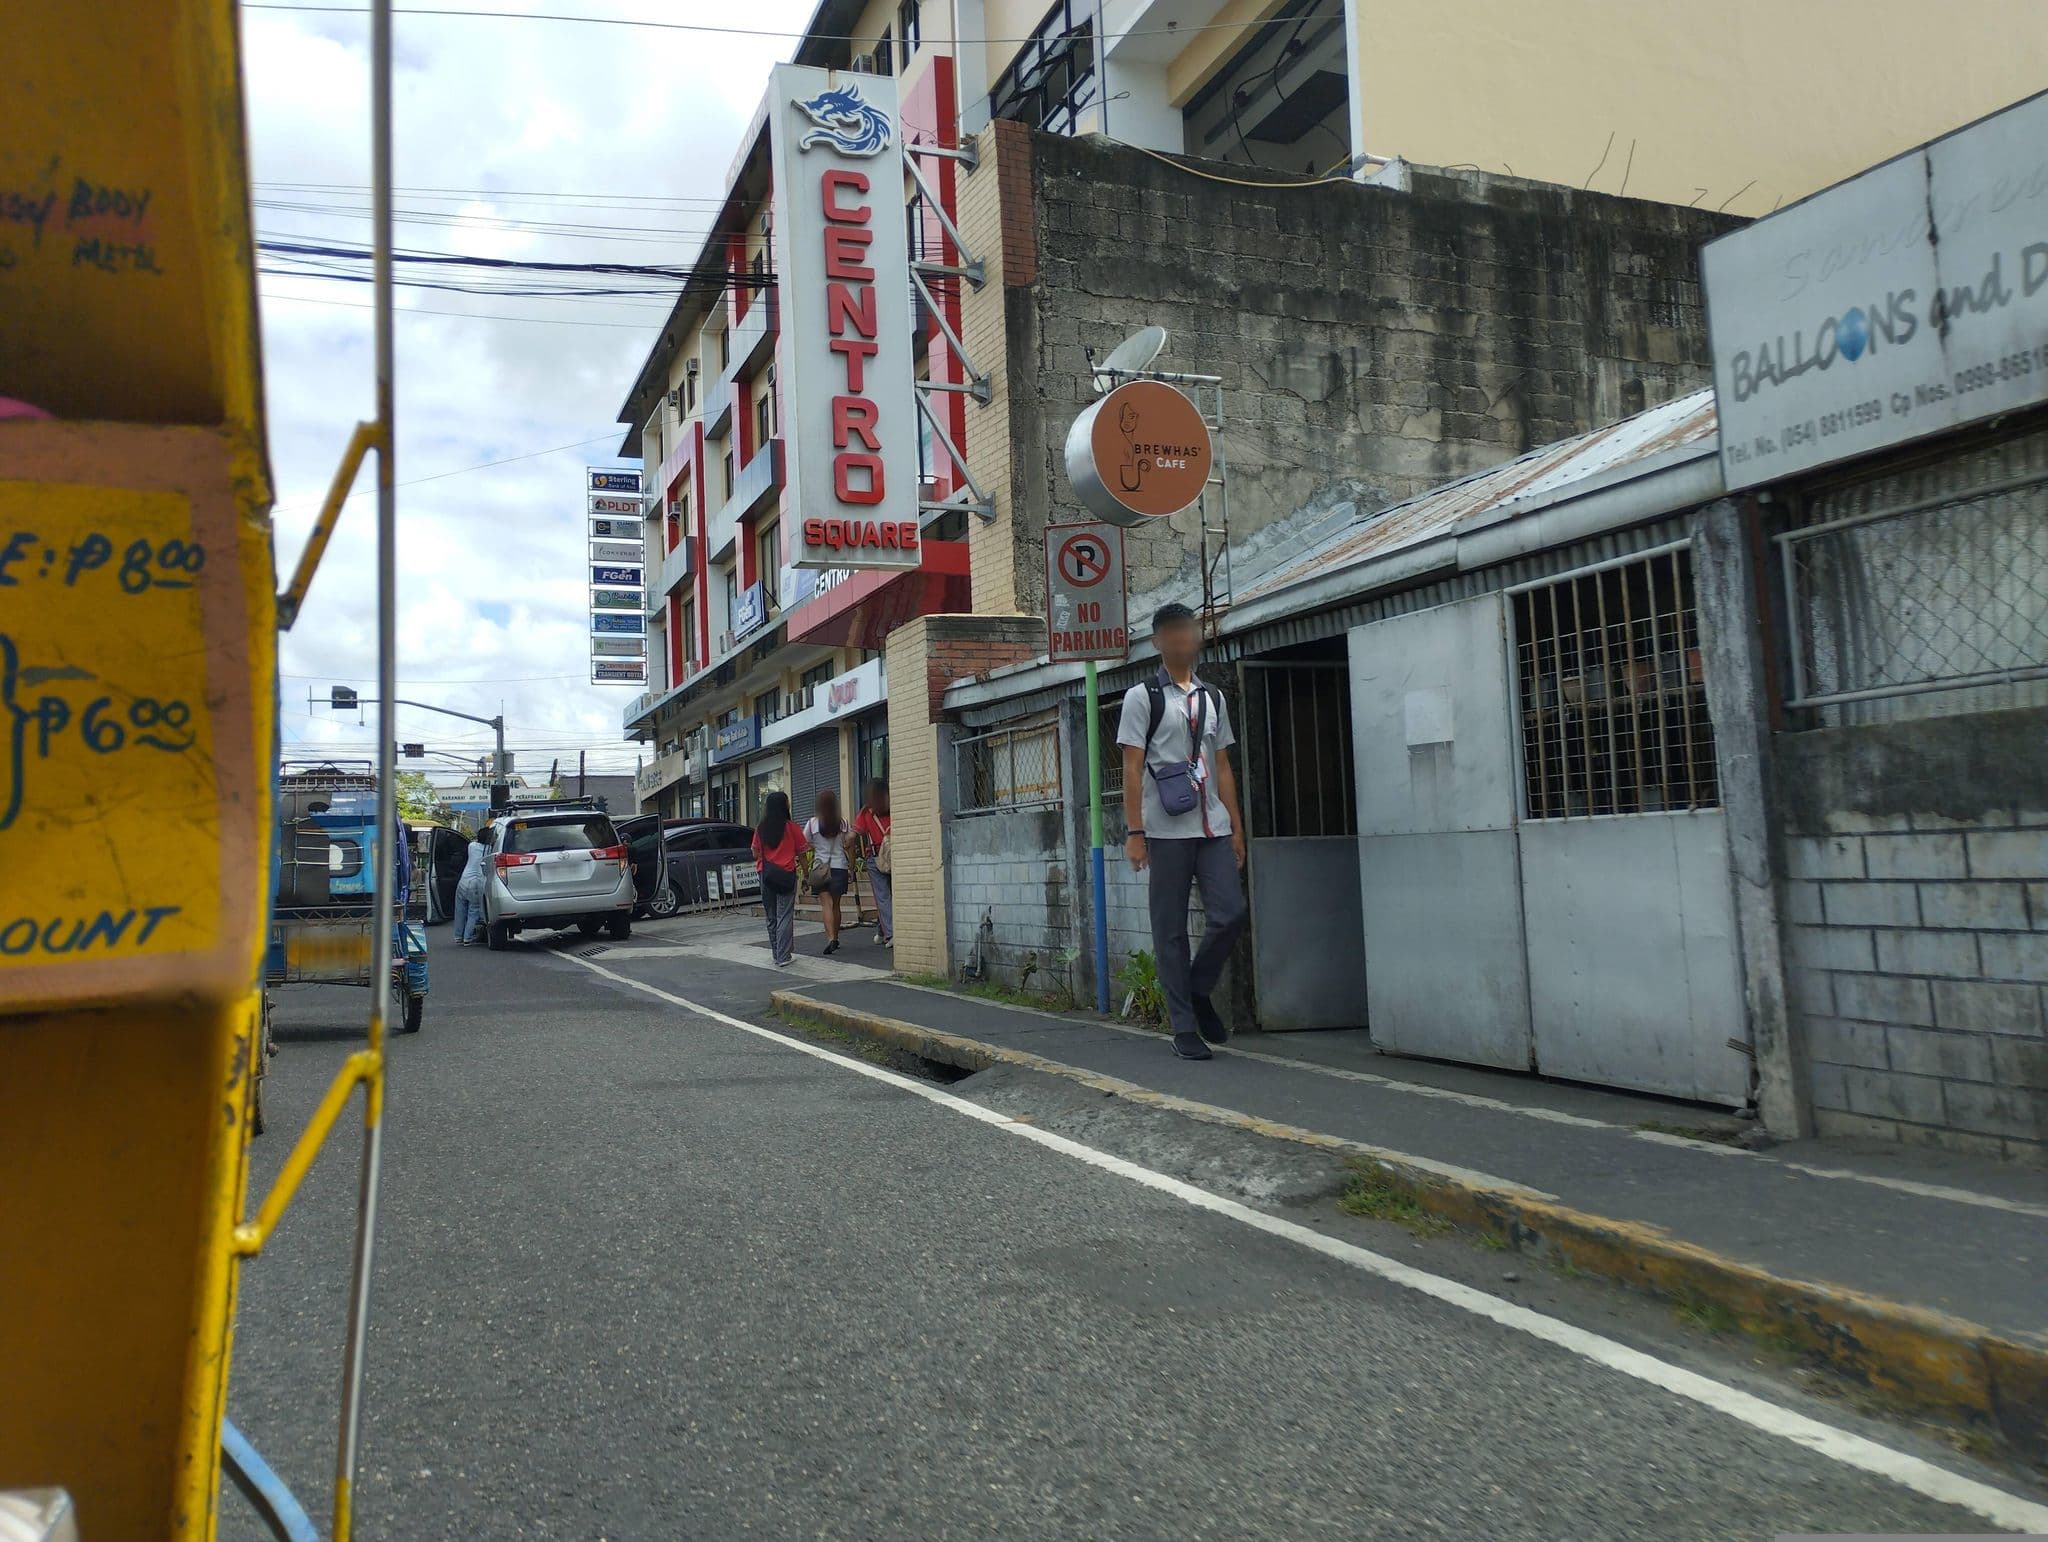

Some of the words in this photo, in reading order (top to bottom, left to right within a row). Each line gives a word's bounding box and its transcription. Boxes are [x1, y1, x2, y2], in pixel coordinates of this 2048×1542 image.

[1929, 251, 2013, 328] and
[821, 168, 886, 506] CENTRO
[607, 501, 638, 513] PLDT
[804, 518, 919, 551] SQUARE
[602, 571, 633, 580] FGen
[1077, 602, 1101, 623] NO
[1053, 627, 1125, 652] PARKING
